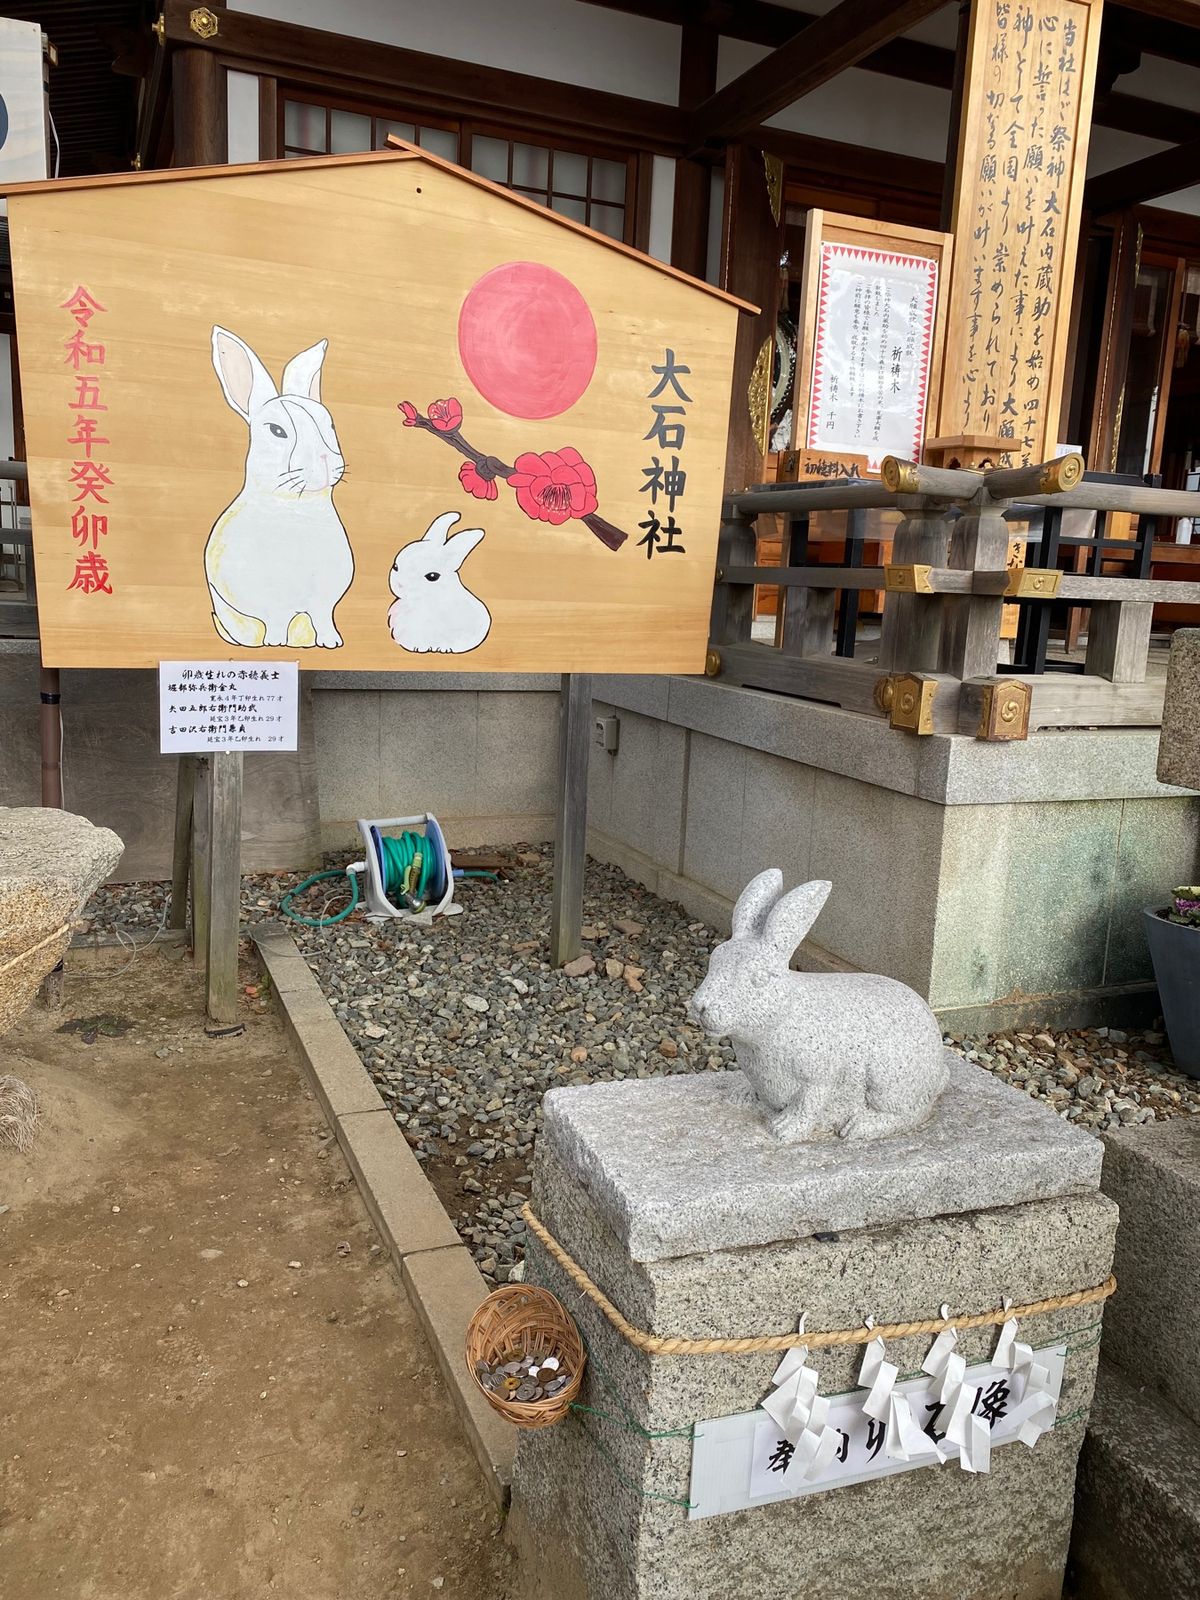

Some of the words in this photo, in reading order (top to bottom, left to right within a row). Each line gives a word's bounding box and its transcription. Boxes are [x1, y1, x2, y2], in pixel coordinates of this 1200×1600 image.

[60, 285, 115, 595] 令和五年癸卯歳
[636, 348, 694, 560] 大石神社
